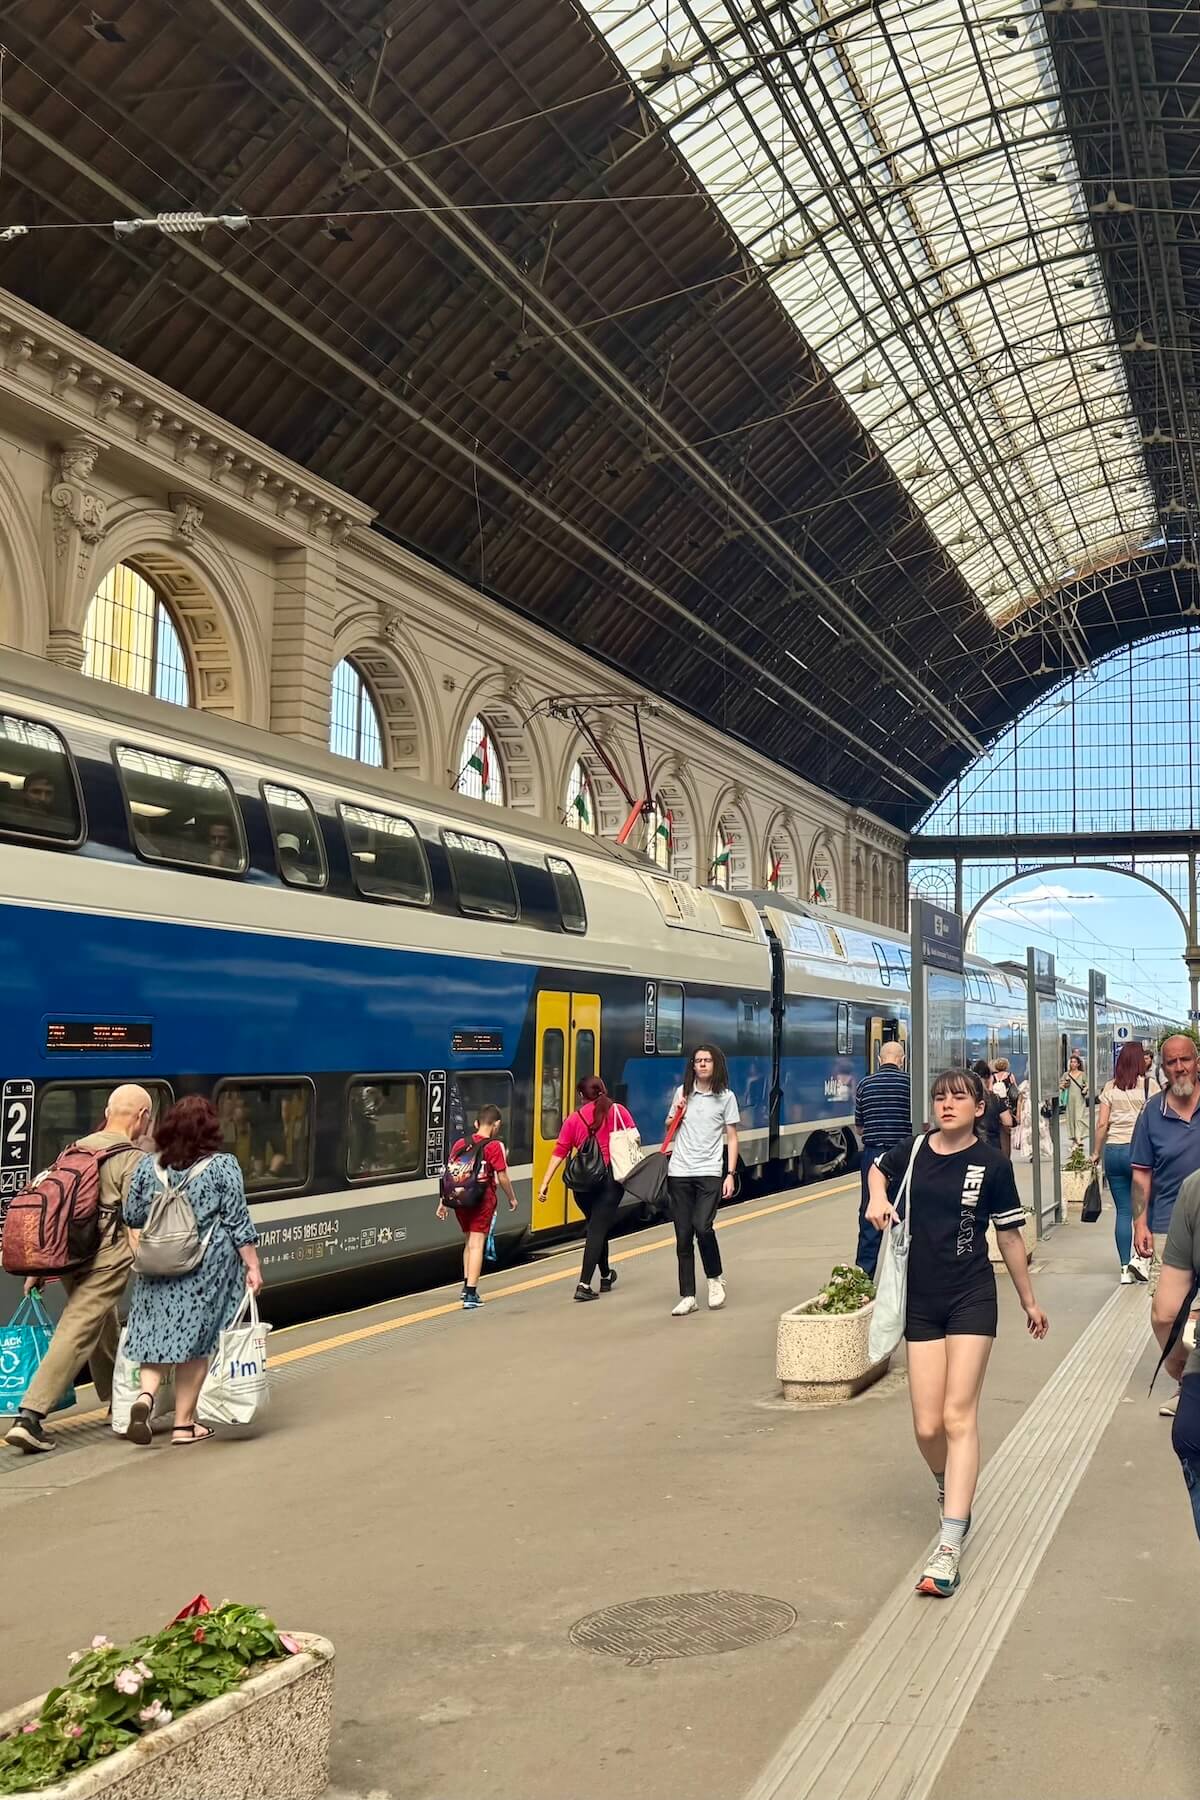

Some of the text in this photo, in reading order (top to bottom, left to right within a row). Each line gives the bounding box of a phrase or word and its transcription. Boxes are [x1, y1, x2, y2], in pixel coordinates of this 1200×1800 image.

[647, 985, 654, 1006] 2
[431, 1086, 442, 1113] 2
[7, 1102, 27, 1143] 2
[960, 1164, 986, 1208] NEW
[282, 1227, 292, 1242] 94
[293, 1226, 303, 1240] 55
[230, 1359, 257, 1378] I'm
